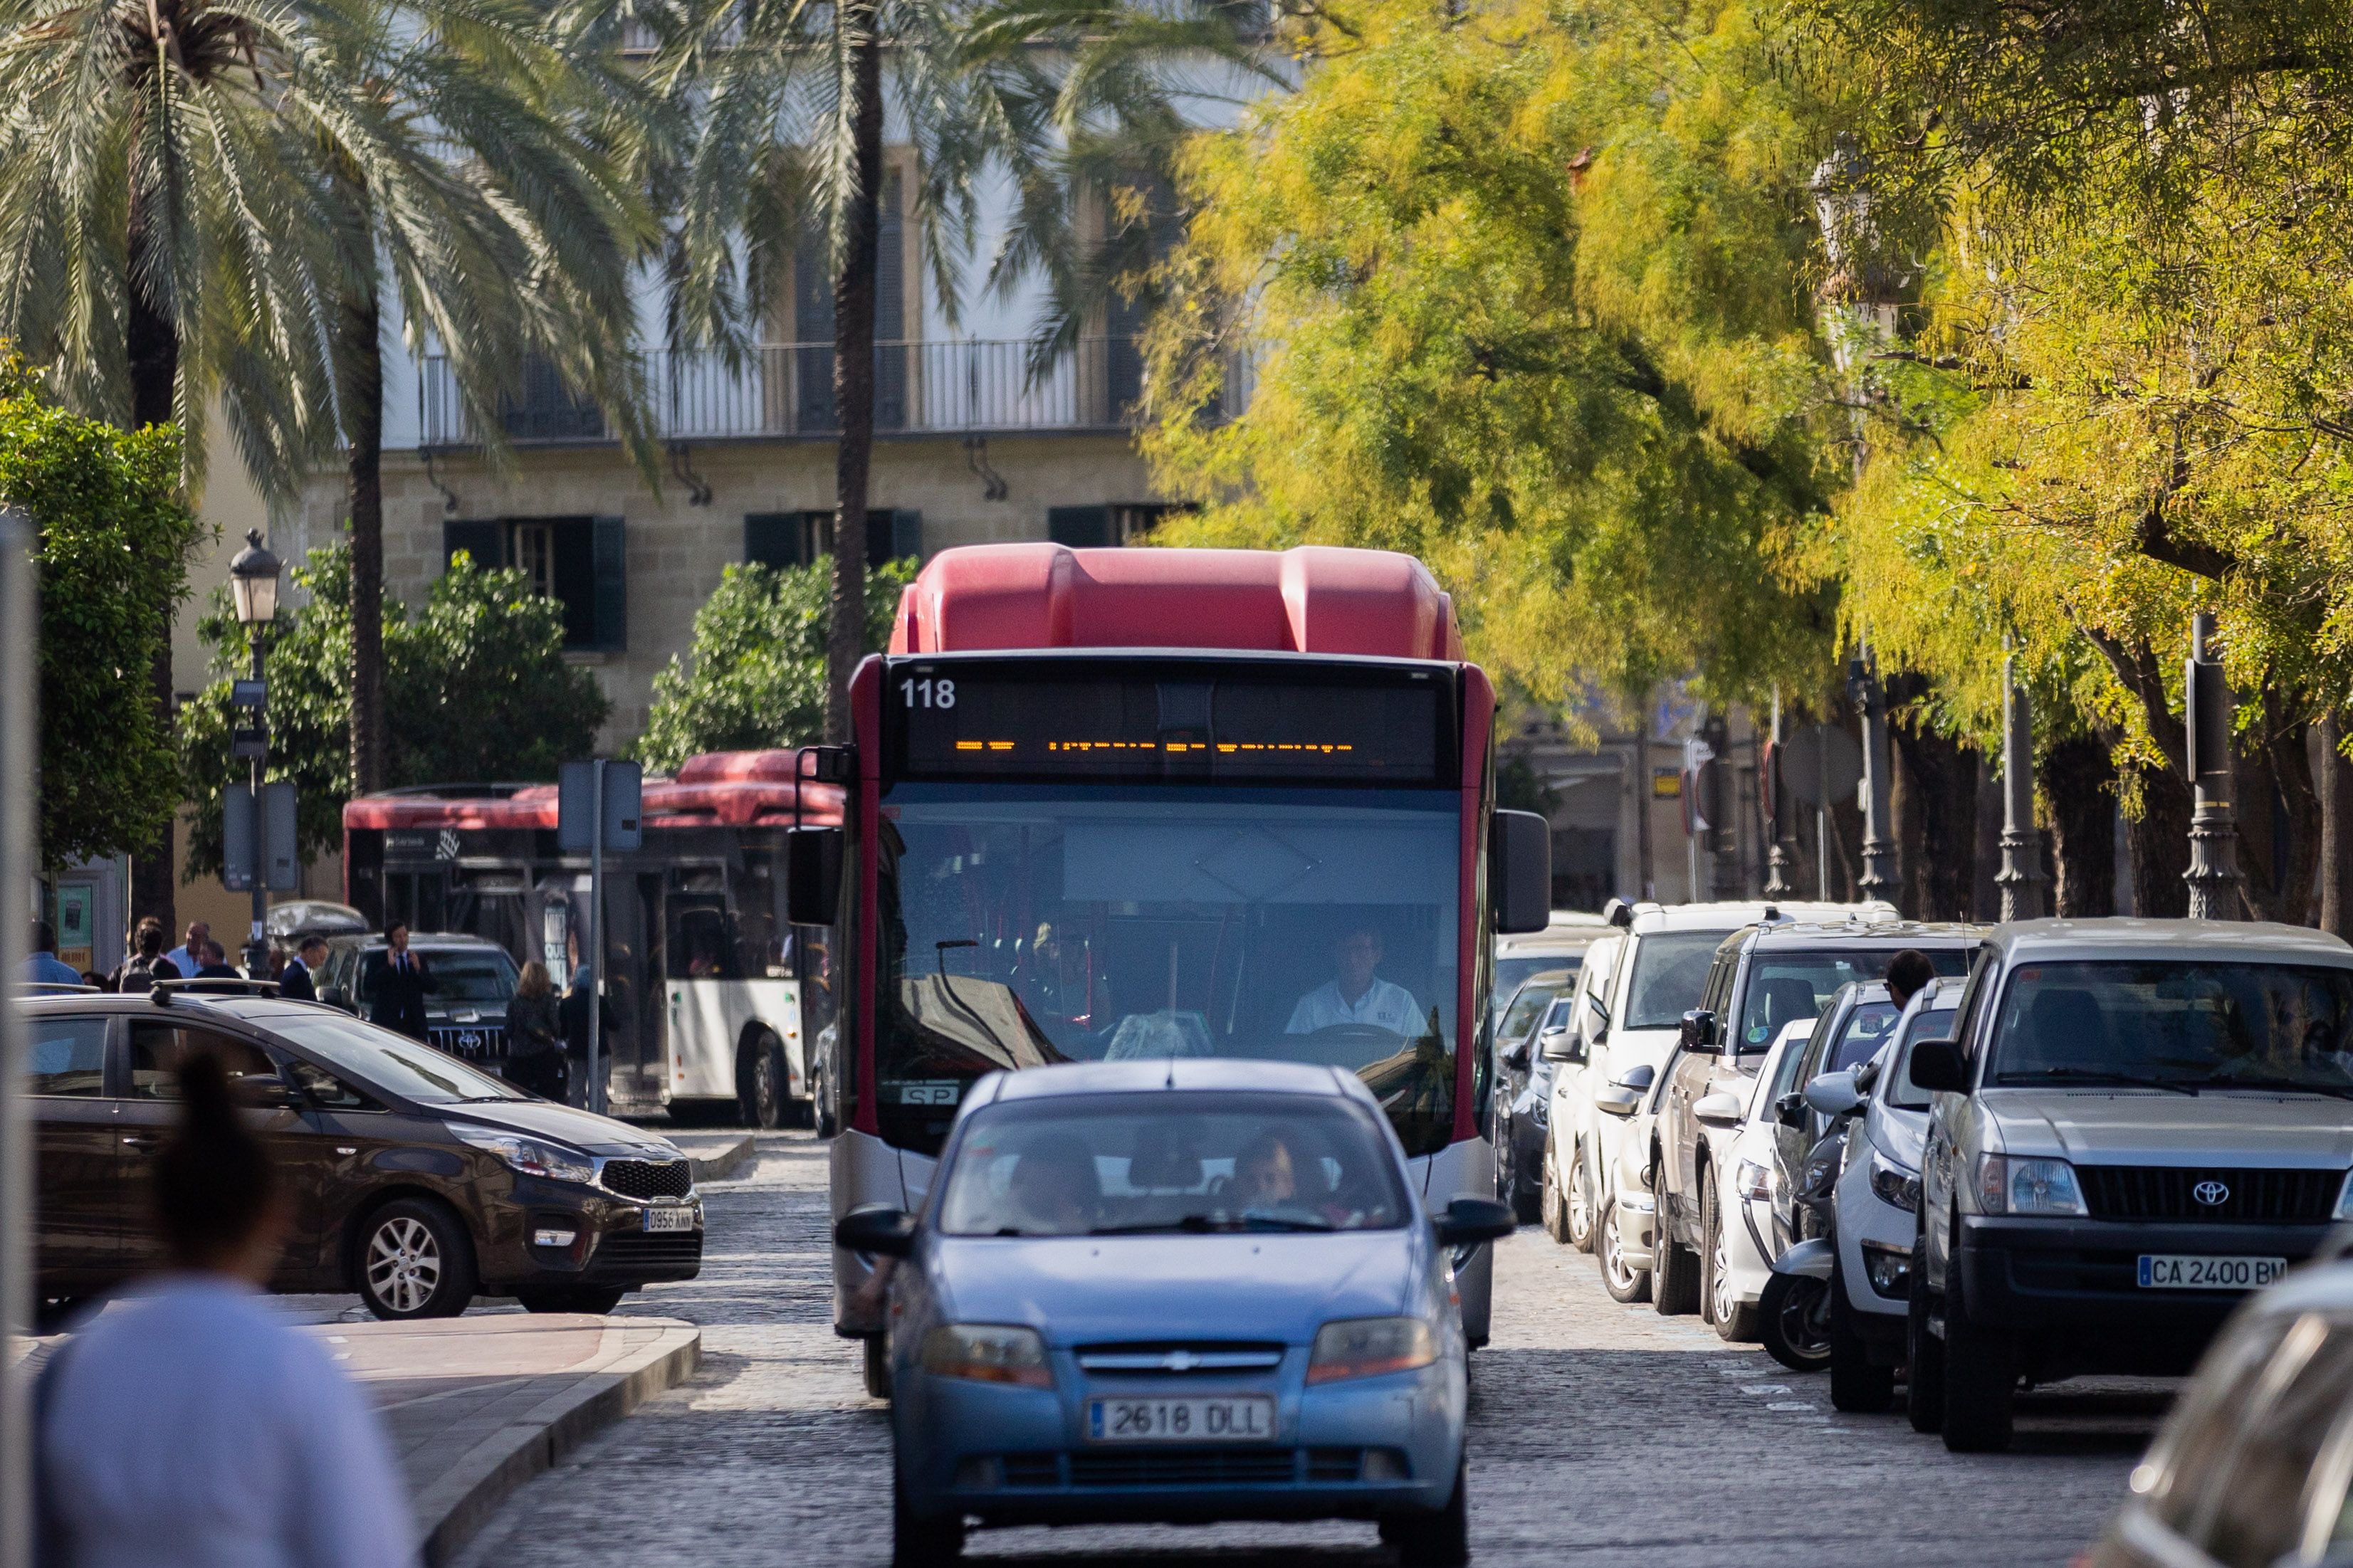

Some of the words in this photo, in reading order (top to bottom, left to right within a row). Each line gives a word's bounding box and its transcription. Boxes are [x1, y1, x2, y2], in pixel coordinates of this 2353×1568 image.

[900, 678, 955, 709] 118
[909, 1089, 950, 1104] SP
[2153, 1260, 2183, 1284] CA
[2189, 1261, 2250, 1285] 2400
[1115, 1404, 1191, 1434] 2618
[1207, 1404, 1263, 1434] DLL
